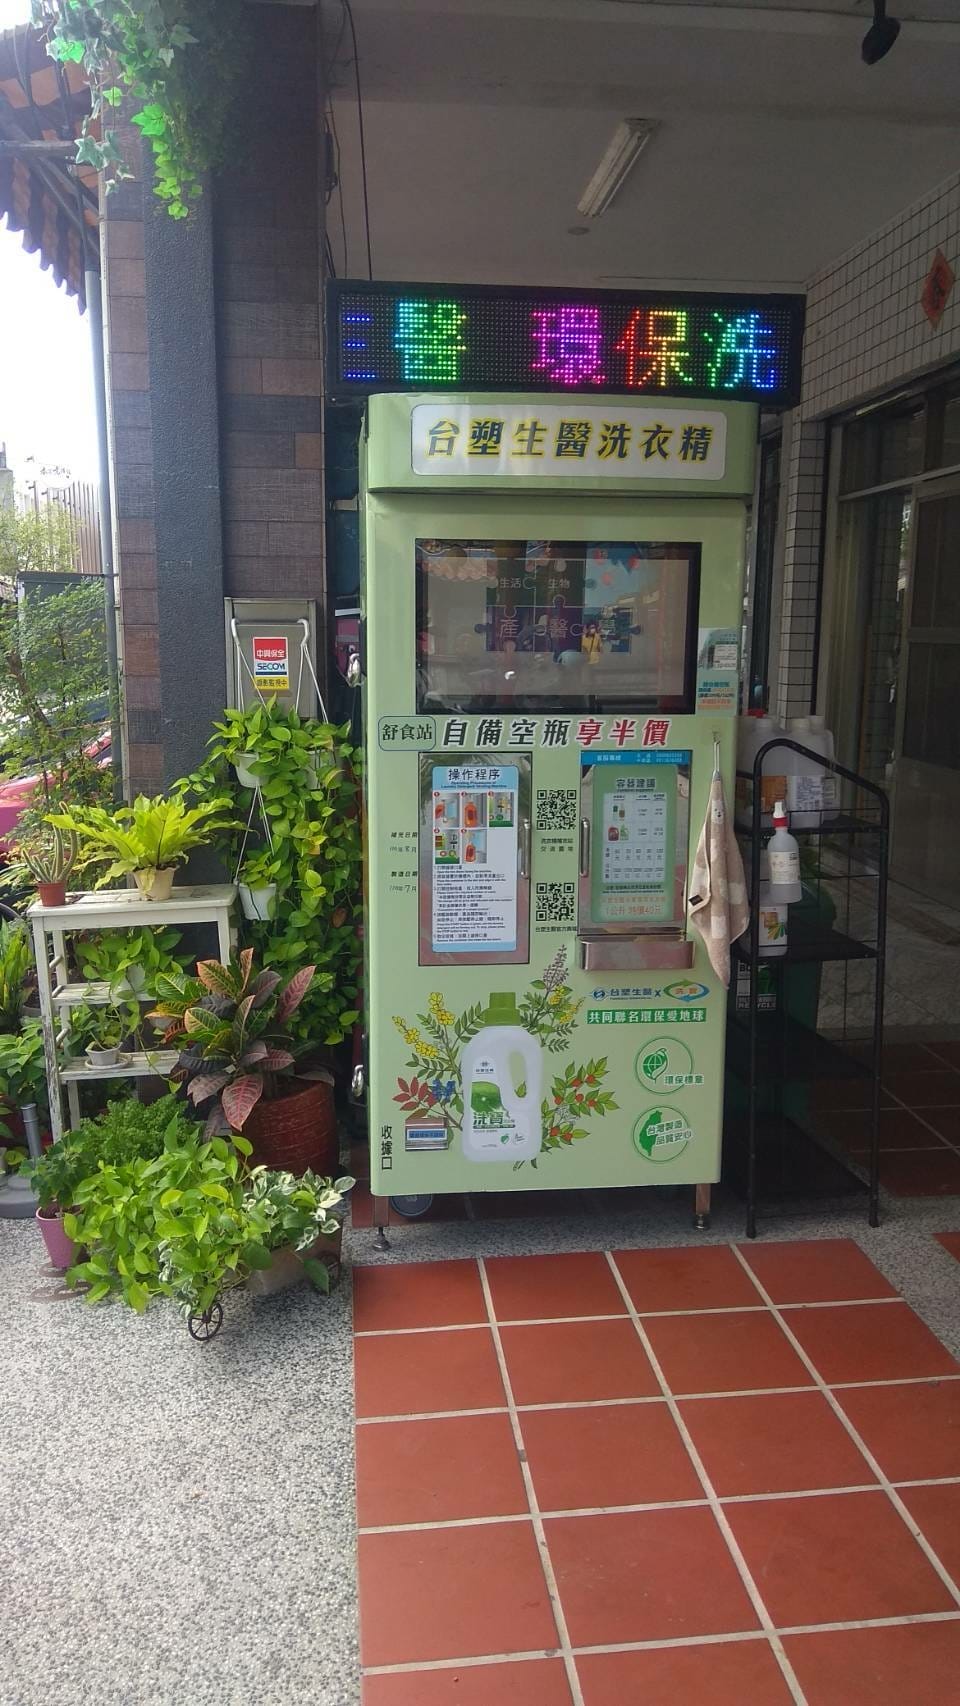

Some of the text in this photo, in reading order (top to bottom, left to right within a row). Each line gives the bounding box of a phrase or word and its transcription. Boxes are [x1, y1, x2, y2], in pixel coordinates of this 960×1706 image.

[531, 305, 776, 388] 環保洗
[427, 419, 714, 462] 台塑生醫洗衣精
[499, 577, 570, 589] 生活 生物
[257, 662, 285, 670] SECOM
[382, 723, 432, 741] 舒食站
[442, 718, 670, 746] 自備空瓶享半價
[448, 768, 500, 780] 操作程序
[588, 1009, 704, 1023] 共同聯名環保愛地球
